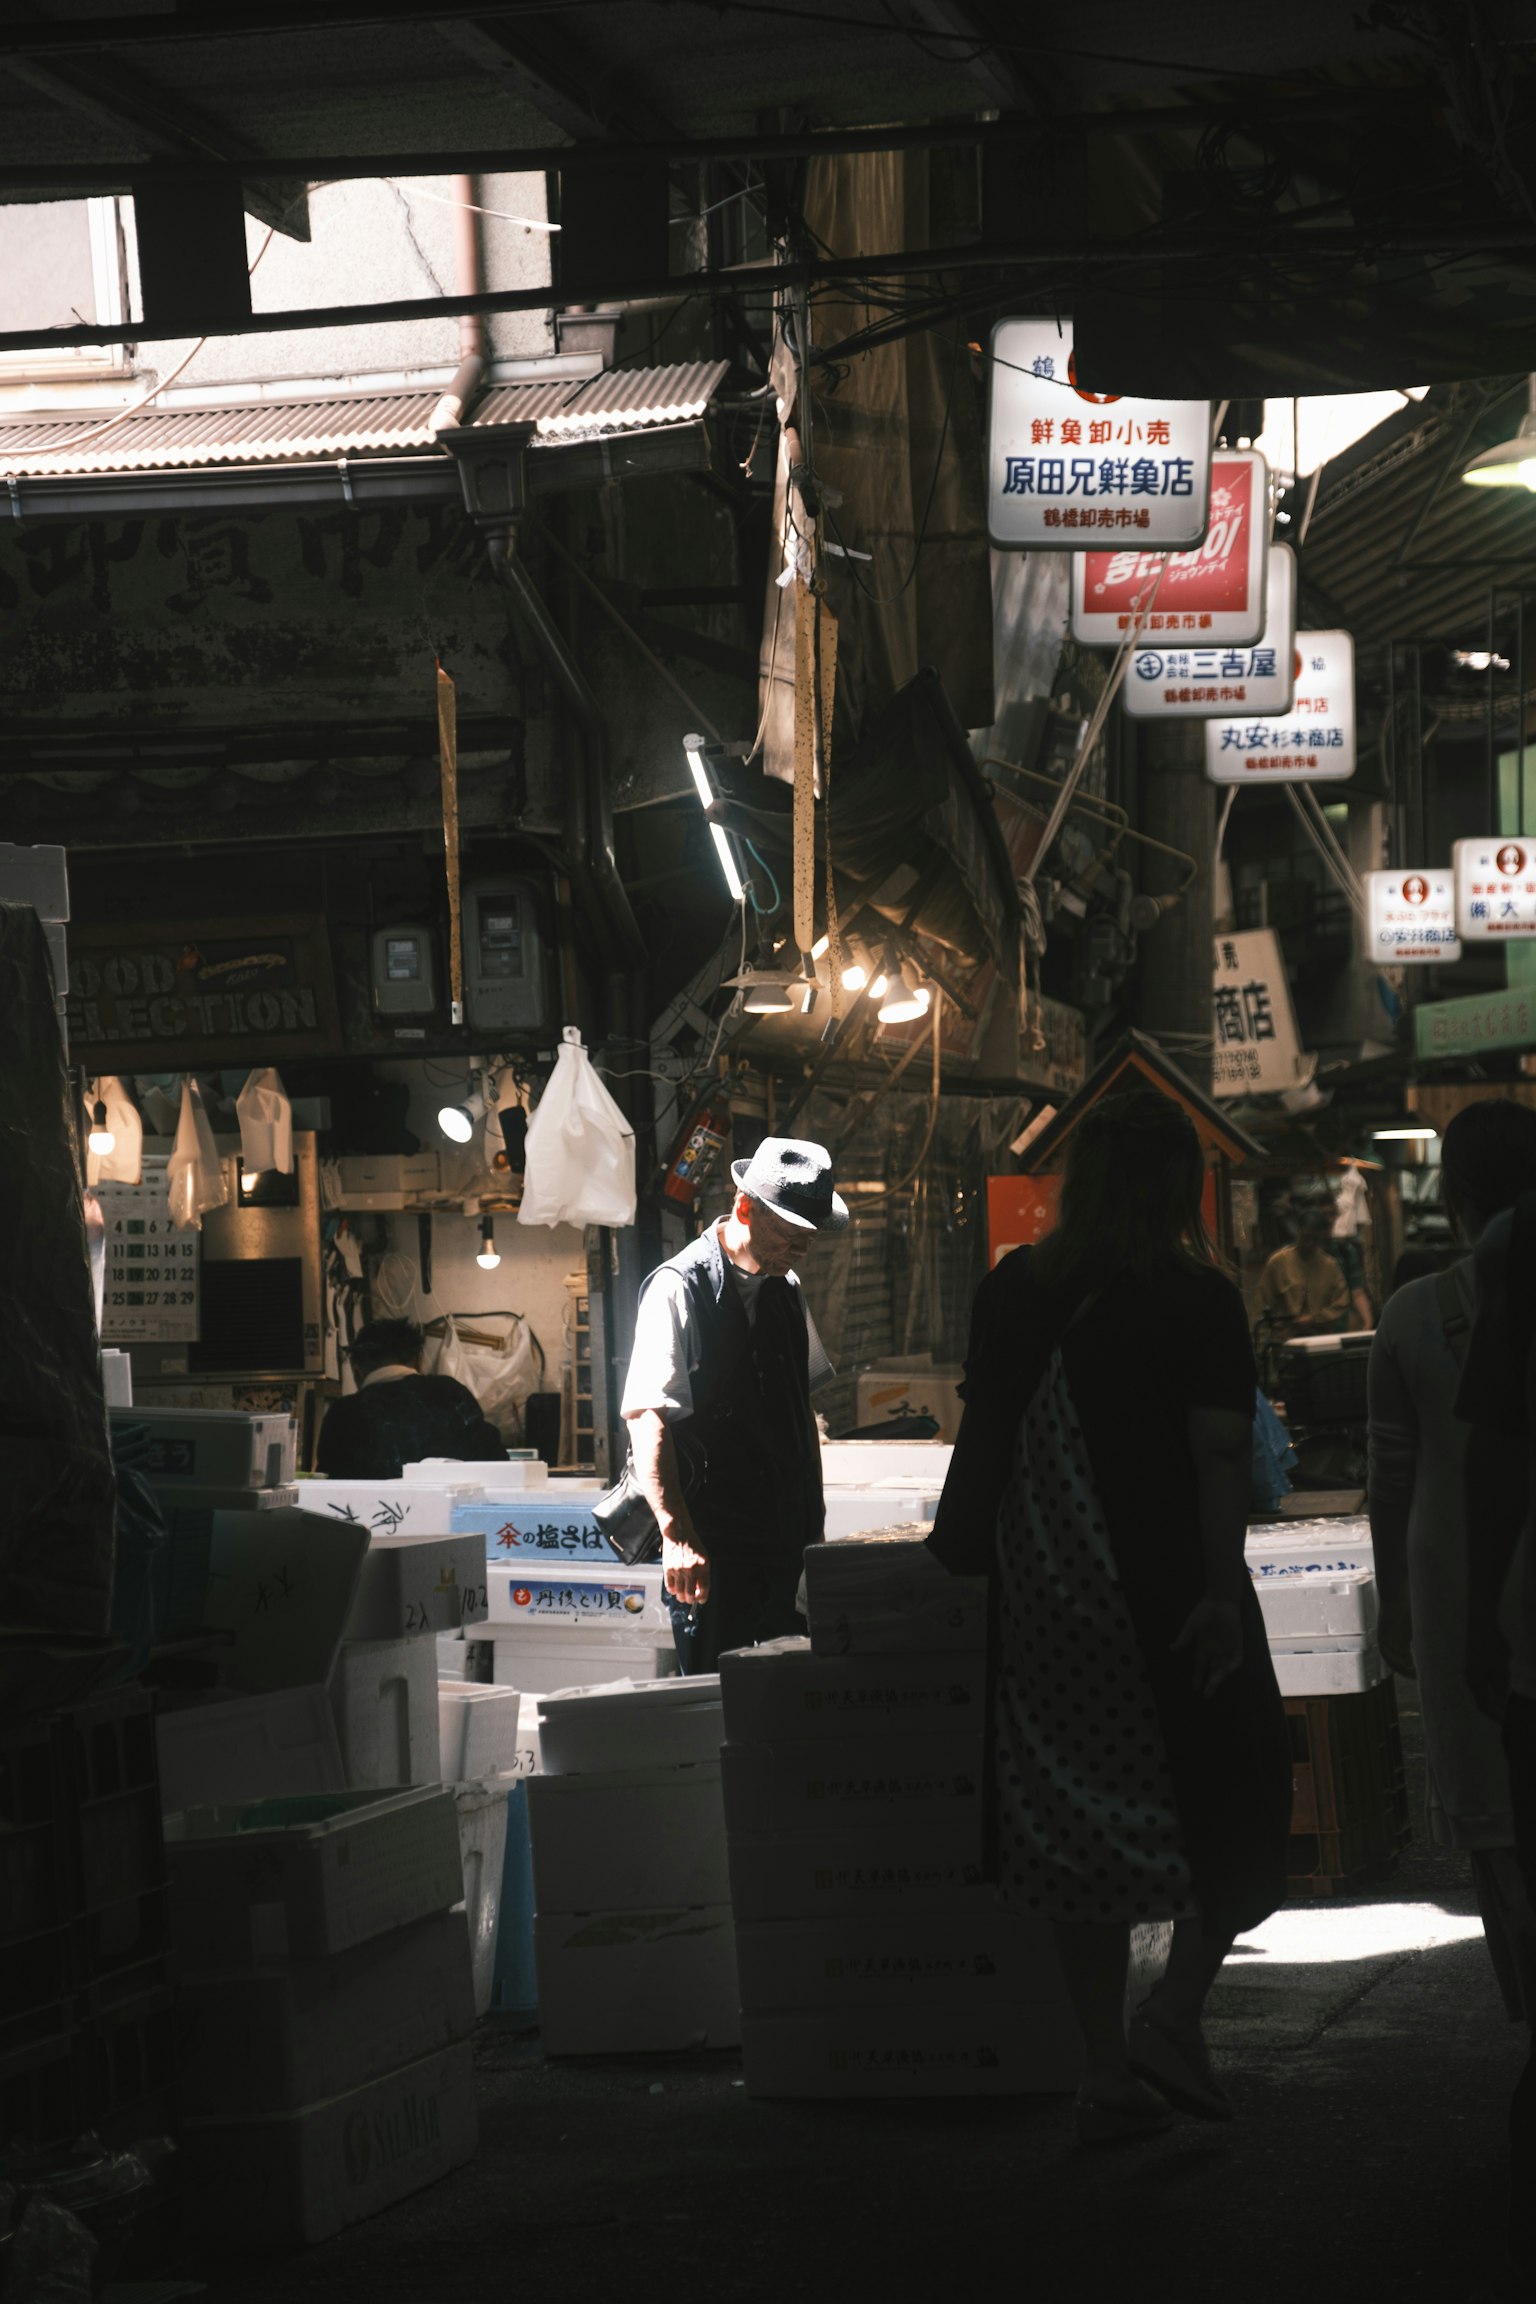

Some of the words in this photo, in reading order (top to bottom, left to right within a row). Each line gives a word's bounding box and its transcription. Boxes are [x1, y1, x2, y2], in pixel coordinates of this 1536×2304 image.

[1043, 507, 1150, 529] 鶴橋卸売市場
[113, 1244, 124, 1257] 11
[131, 1244, 142, 1257] 12
[147, 1244, 159, 1257] 13
[164, 1244, 176, 1257] 14
[181, 1244, 193, 1257] 15
[113, 1269, 124, 1281] 18
[130, 1269, 141, 1281] 19
[146, 1269, 159, 1281] 20
[164, 1269, 176, 1281] 21
[181, 1269, 194, 1281] 22
[112, 1292, 125, 1305] 25
[130, 1292, 141, 1305] 26
[146, 1292, 159, 1305] 27
[164, 1292, 176, 1305] 28
[181, 1292, 194, 1305] 29
